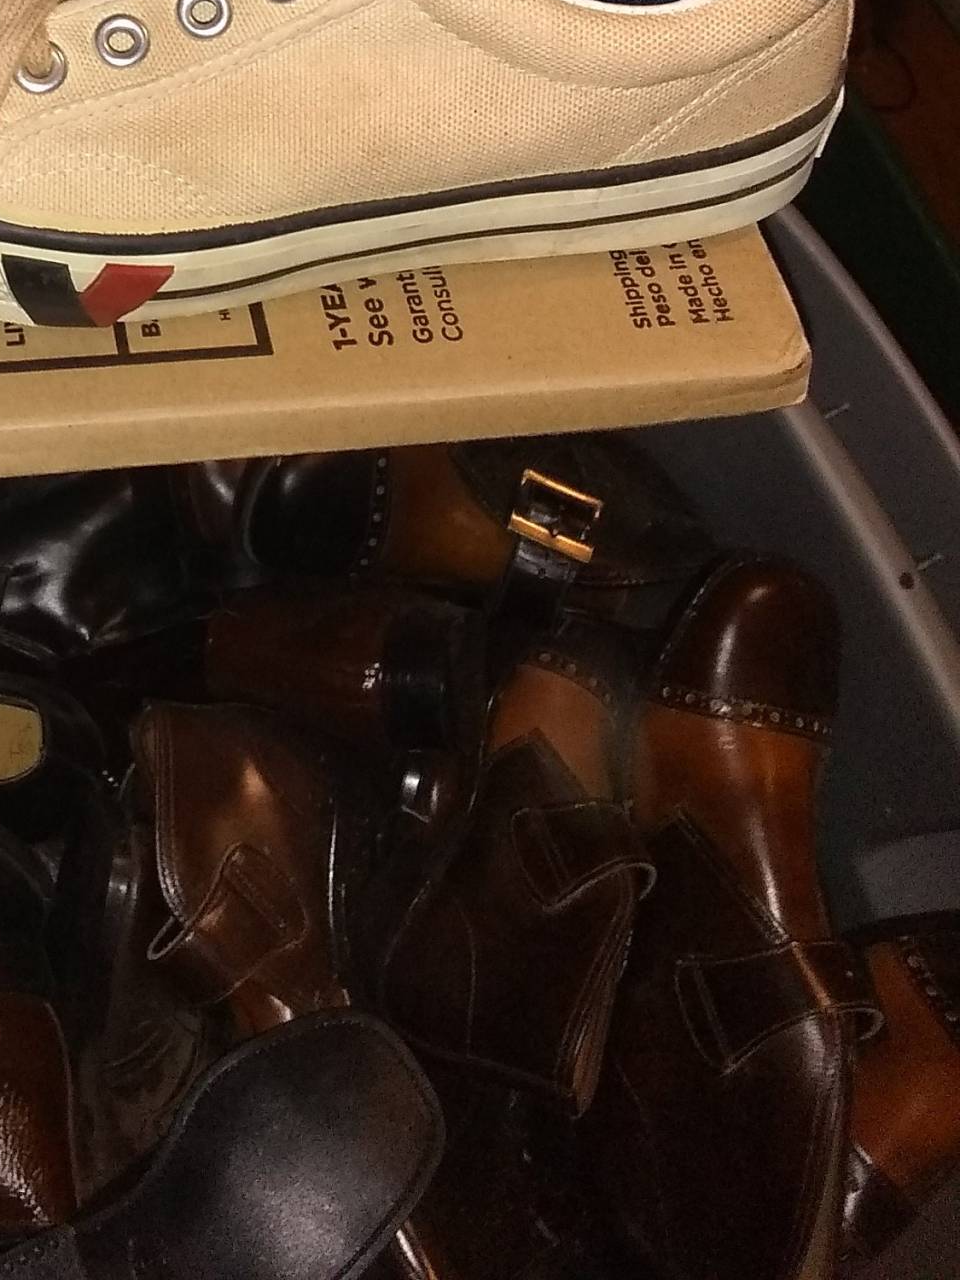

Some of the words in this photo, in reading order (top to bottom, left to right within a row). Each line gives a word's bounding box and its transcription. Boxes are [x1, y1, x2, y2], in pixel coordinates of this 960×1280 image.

[629, 250, 656, 278] del
[669, 253, 687, 270] in
[686, 239, 707, 259] en
[608, 250, 652, 329] Shipping
[677, 274, 710, 324] Made
[698, 264, 734, 322] Hecho
[363, 297, 394, 346] See
